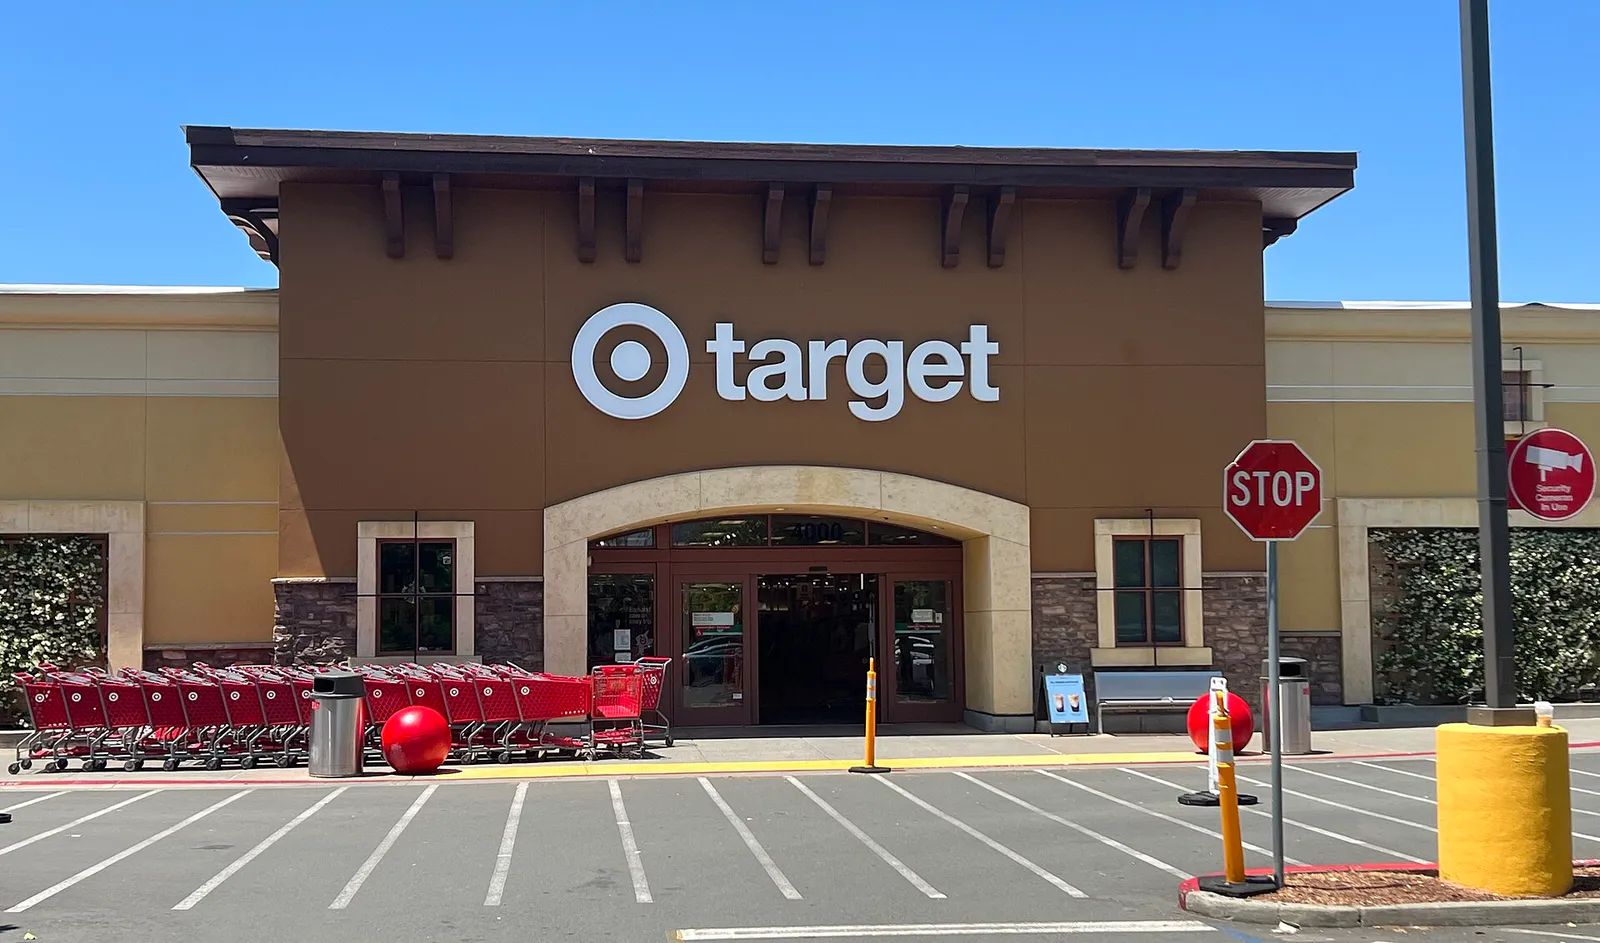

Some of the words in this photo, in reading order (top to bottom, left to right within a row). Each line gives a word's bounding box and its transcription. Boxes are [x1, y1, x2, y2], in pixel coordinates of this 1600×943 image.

[706, 322, 1000, 422] target
[1231, 470, 1315, 507] STOP
[1536, 484, 1571, 494] Security
[1540, 502, 1550, 511] In
